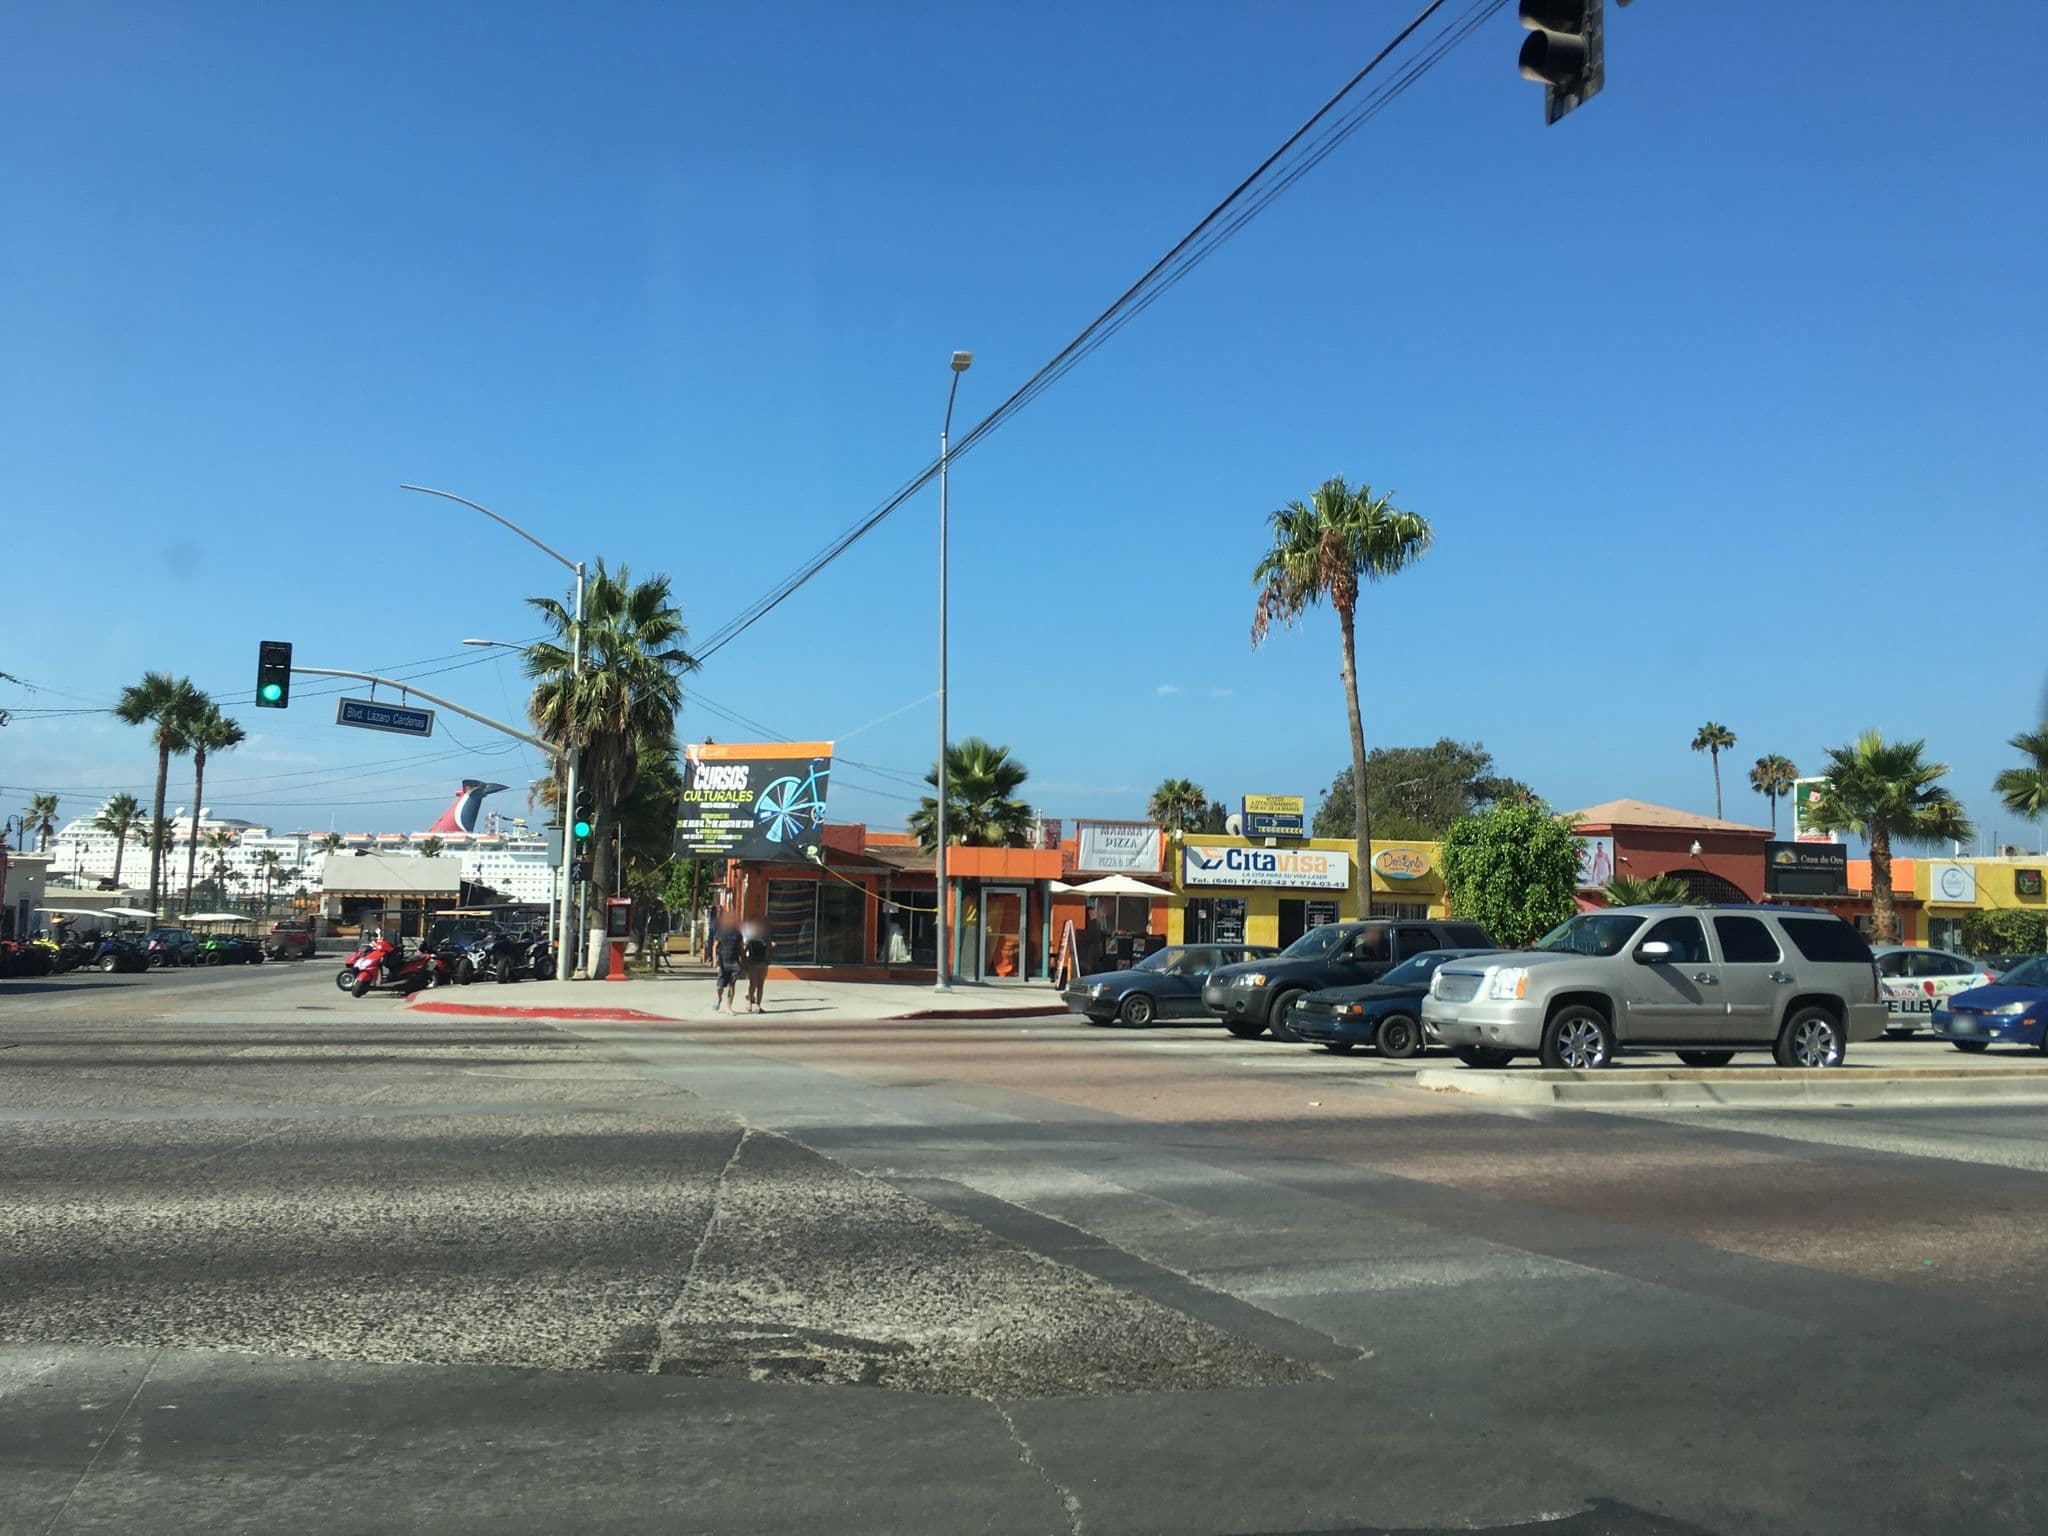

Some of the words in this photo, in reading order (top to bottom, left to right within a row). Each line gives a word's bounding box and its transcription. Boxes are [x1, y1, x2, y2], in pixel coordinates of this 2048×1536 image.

[346, 706, 364, 719] Blvd.
[693, 765, 749, 791] CURSOS
[683, 790, 754, 802] CULTURALES
[1105, 838, 1137, 848] PIZZA
[1226, 848, 1328, 874] Citavisa
[1801, 855, 1819, 864] Casa
[1820, 856, 1829, 864] de
[1830, 856, 1845, 865] Oro
